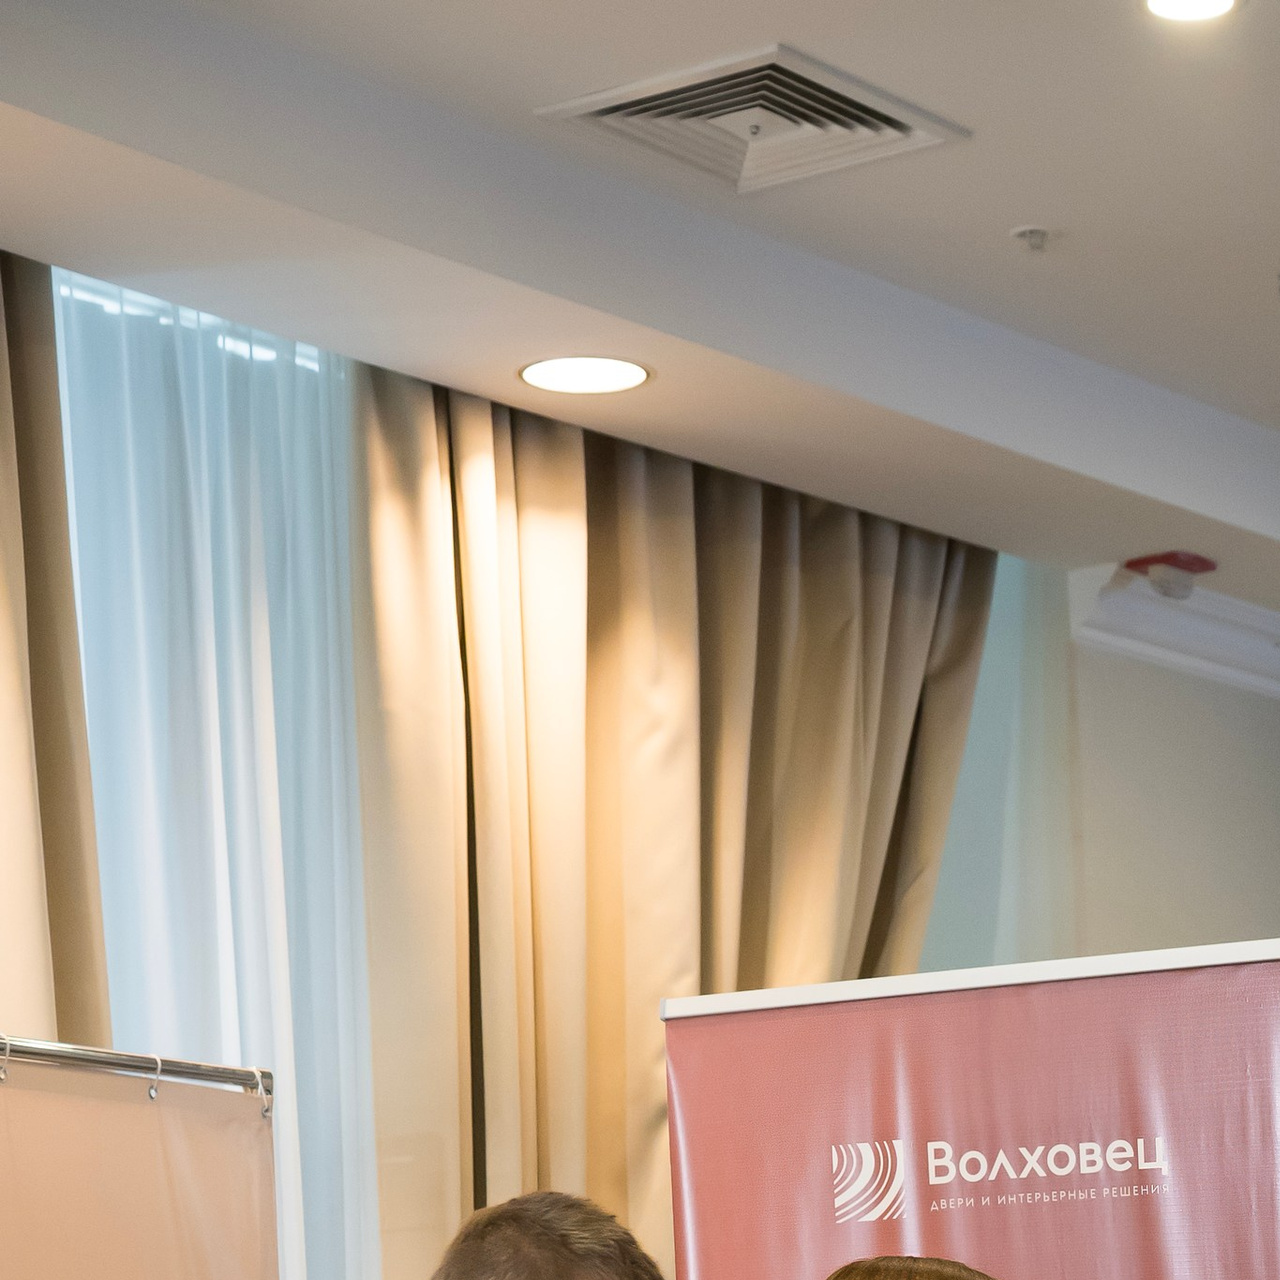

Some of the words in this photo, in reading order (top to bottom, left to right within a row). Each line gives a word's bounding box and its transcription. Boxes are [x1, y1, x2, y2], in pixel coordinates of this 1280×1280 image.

[927, 1136, 1169, 1184] Волховец
[930, 1197, 975, 1212] ДВЕРИ
[981, 1195, 991, 1206] И
[997, 1187, 1097, 1206] ИНТЕРЬЕРНЫЕ
[1102, 1183, 1170, 1198] РЕШЕНИЯ
